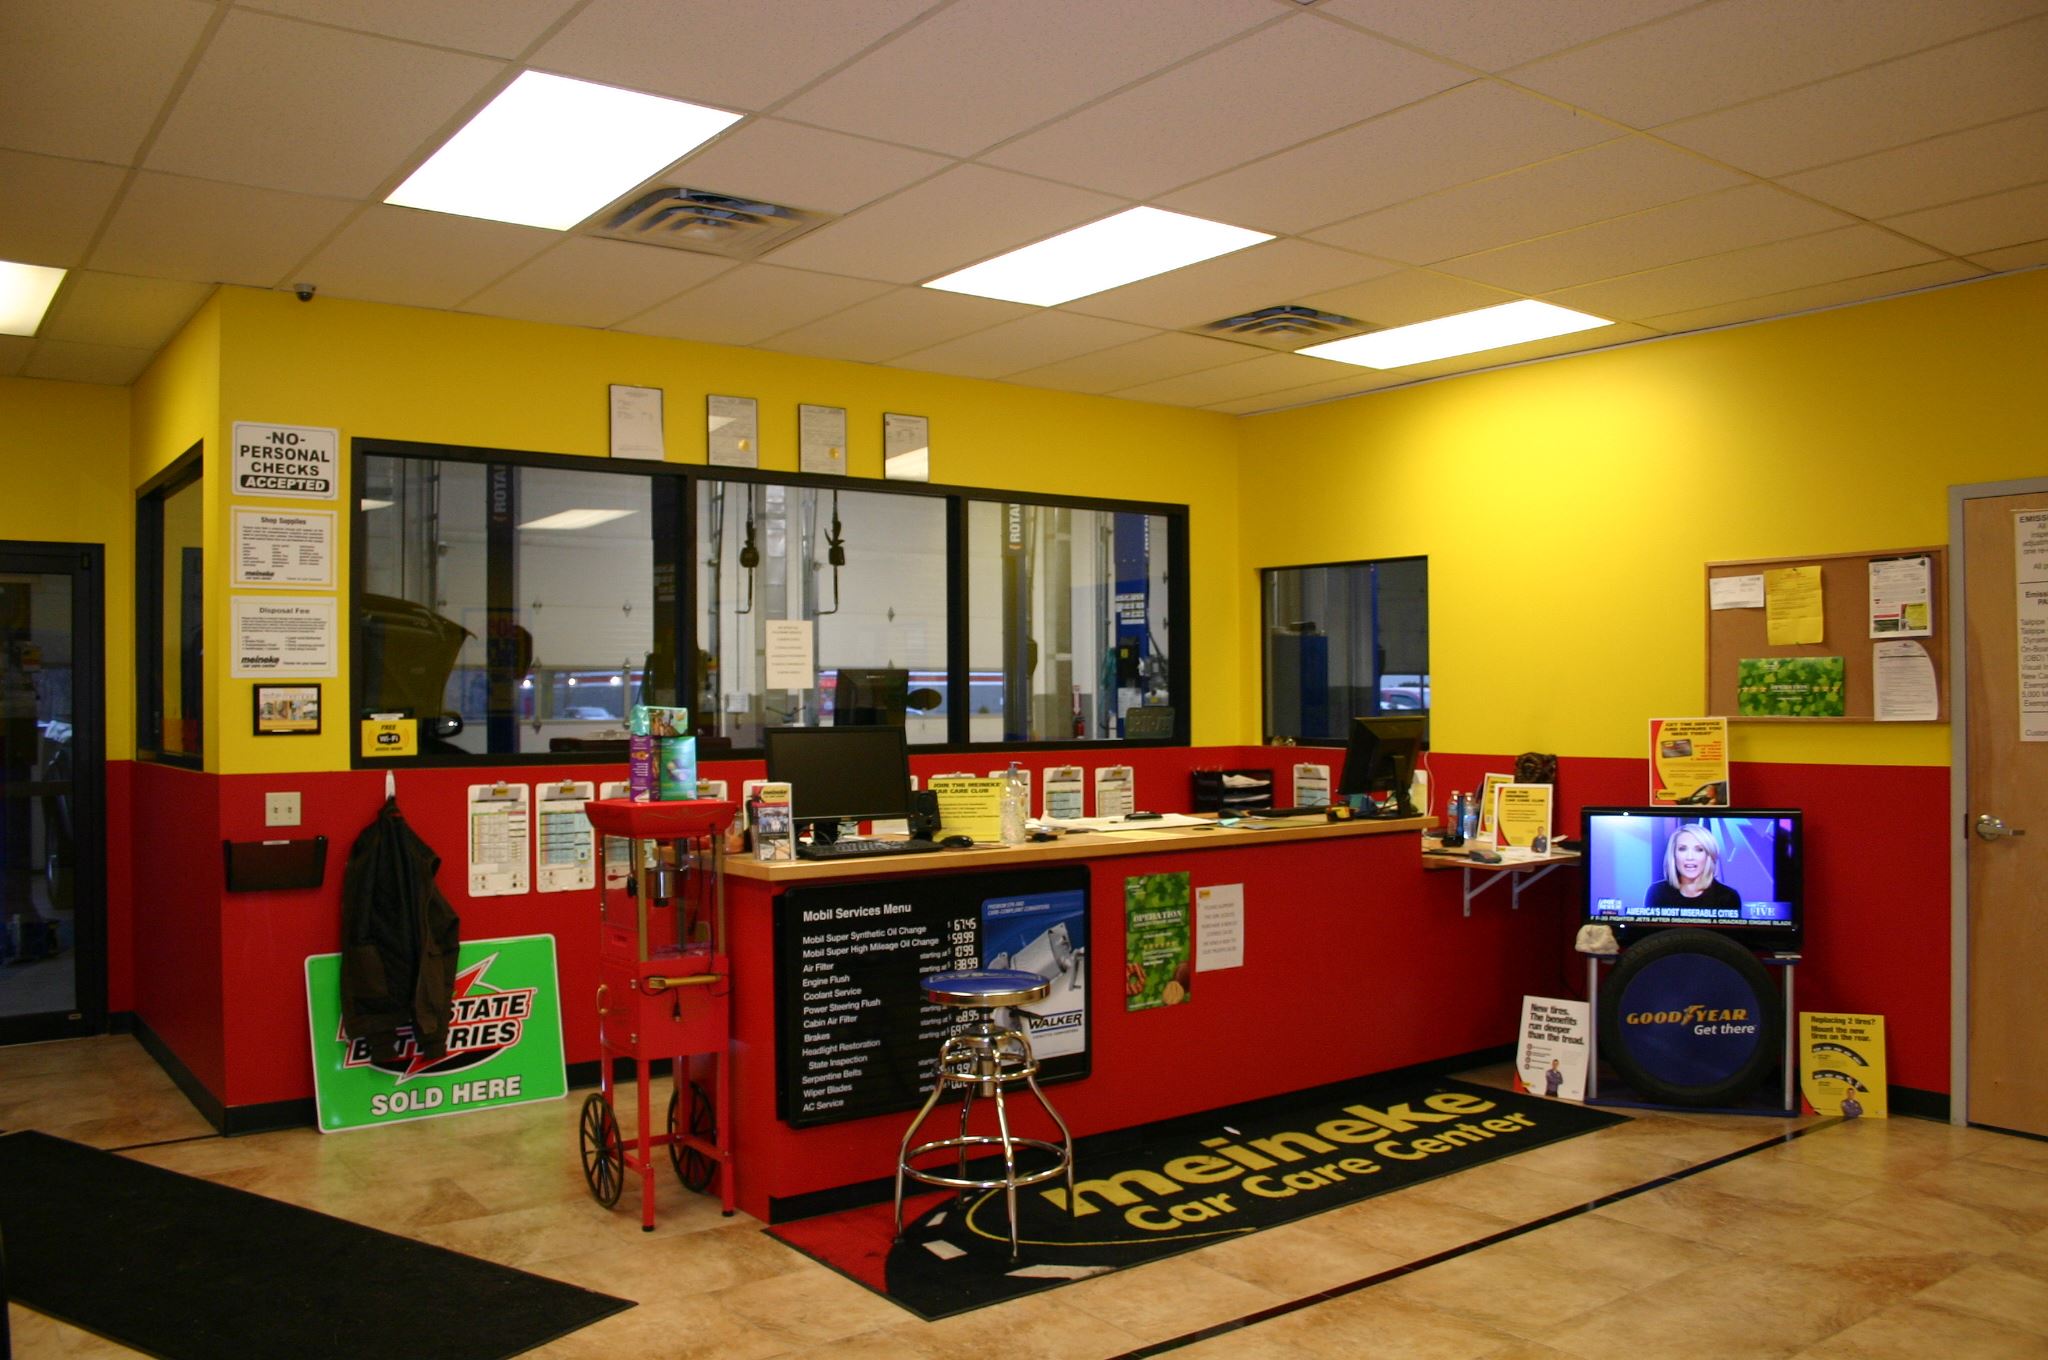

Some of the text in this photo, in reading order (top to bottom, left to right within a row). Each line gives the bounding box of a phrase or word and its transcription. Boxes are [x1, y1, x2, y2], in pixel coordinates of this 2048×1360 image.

[240, 445, 330, 463] PERSONAL
[251, 461, 320, 476] CHECKS
[245, 476, 326, 491] ACCEPTED
[261, 516, 307, 525] Shop Supplies
[2019, 514, 2048, 523] EMISS
[241, 655, 280, 664] meineke
[803, 903, 912, 922] Mobil Services Menu
[1626, 907, 1660, 916] AMERICA'S
[1661, 907, 1680, 917] MOST
[1680, 908, 1718, 917] MISERABLE
[1718, 909, 1739, 918] CITIES
[802, 934, 825, 945] Mobil
[826, 932, 849, 944] Super
[850, 929, 885, 942] Synthetic
[887, 927, 897, 936] Oil
[899, 925, 927, 936] Change
[802, 948, 825, 959] Mobil
[826, 946, 849, 958] Super
[850, 944, 869, 955] High
[870, 940, 899, 952] Mileage
[900, 938, 910, 948] Oil
[911, 936, 939, 947] Change
[803, 965, 814, 973] Air
[815, 962, 834, 972] Filter
[802, 977, 829, 988] Engine
[830, 974, 850, 984] Flush
[803, 987, 862, 1001] Coolant Service
[803, 1004, 828, 1015] Power
[829, 1000, 860, 1013] Steering
[861, 998, 881, 1008] Flush
[803, 1019, 826, 1029] Cabin
[827, 1017, 838, 1026] Air
[839, 1014, 858, 1024] Filter
[1029, 1013, 1082, 1030] WALKER
[1530, 1012, 1578, 1026] The benefits
[1626, 1005, 1749, 1026] GOODYEAR
[1527, 1030, 1545, 1040] than
[1547, 1032, 1559, 1042] the
[1528, 1022, 1571, 1035] run deeper
[1694, 1023, 1755, 1036] Get there
[804, 1032, 831, 1043] Brakes
[802, 1039, 881, 1057] Headlight Restoration
[808, 1055, 868, 1070] State Inspection
[802, 1072, 842, 1085] Serpentine
[843, 1068, 862, 1079] Belts
[370, 1075, 522, 1116] SOLD HERE
[803, 1083, 853, 1099] Wiper Blades
[803, 1099, 844, 1112] AC Service
[1039, 1092, 1497, 1217] meineke
[1123, 1112, 1537, 1231] Car Care Center
